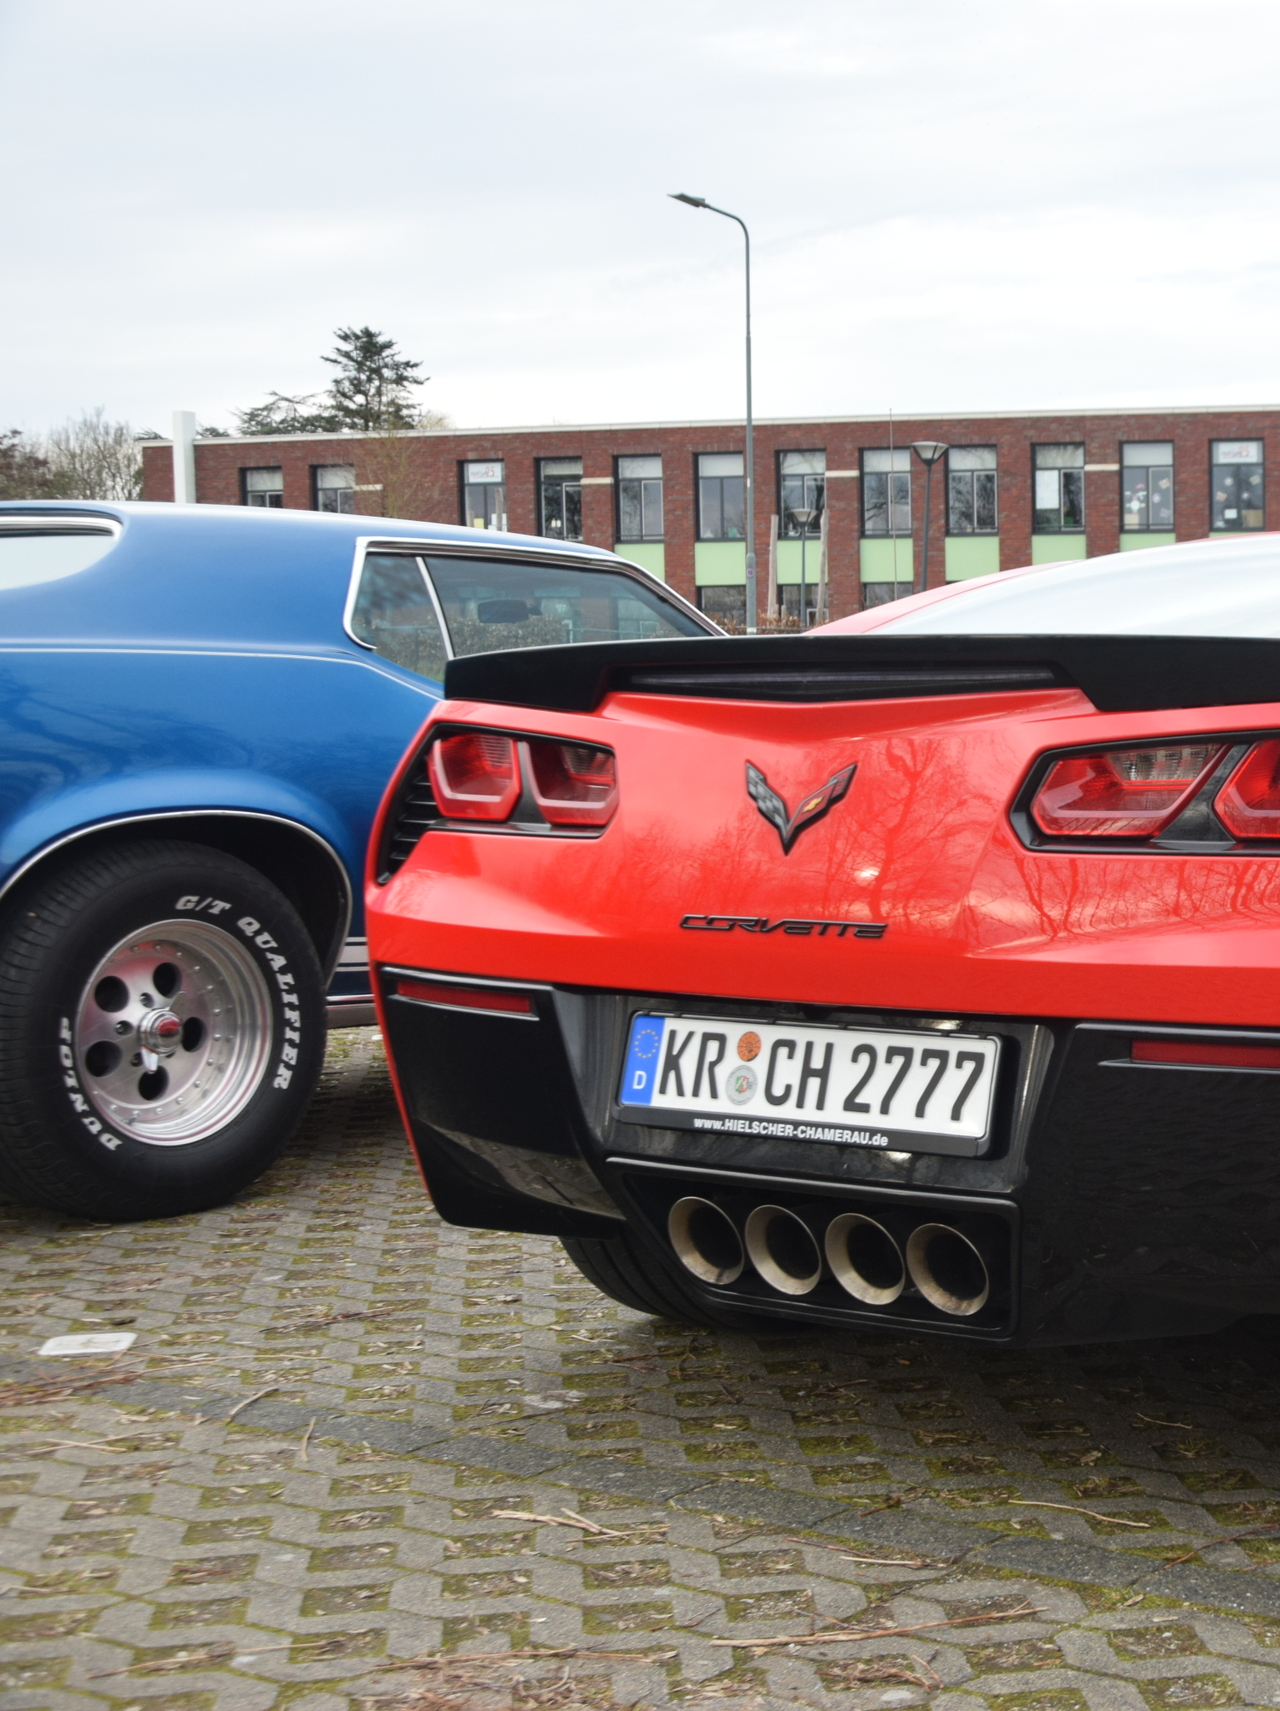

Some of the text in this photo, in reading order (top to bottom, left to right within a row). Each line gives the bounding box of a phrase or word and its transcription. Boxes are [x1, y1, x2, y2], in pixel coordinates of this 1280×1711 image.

[680, 916, 888, 940] CORVETTE
[174, 895, 301, 1091] G/T QUALIFIER
[59, 1016, 123, 1151] DUNLOP
[632, 1070, 647, 1090] D
[659, 1029, 727, 1100] KR
[764, 1038, 834, 1111] CH
[843, 1043, 986, 1122] 2777
[694, 1118, 889, 1147] www.HIELSCHER-CHAMERAU.de
